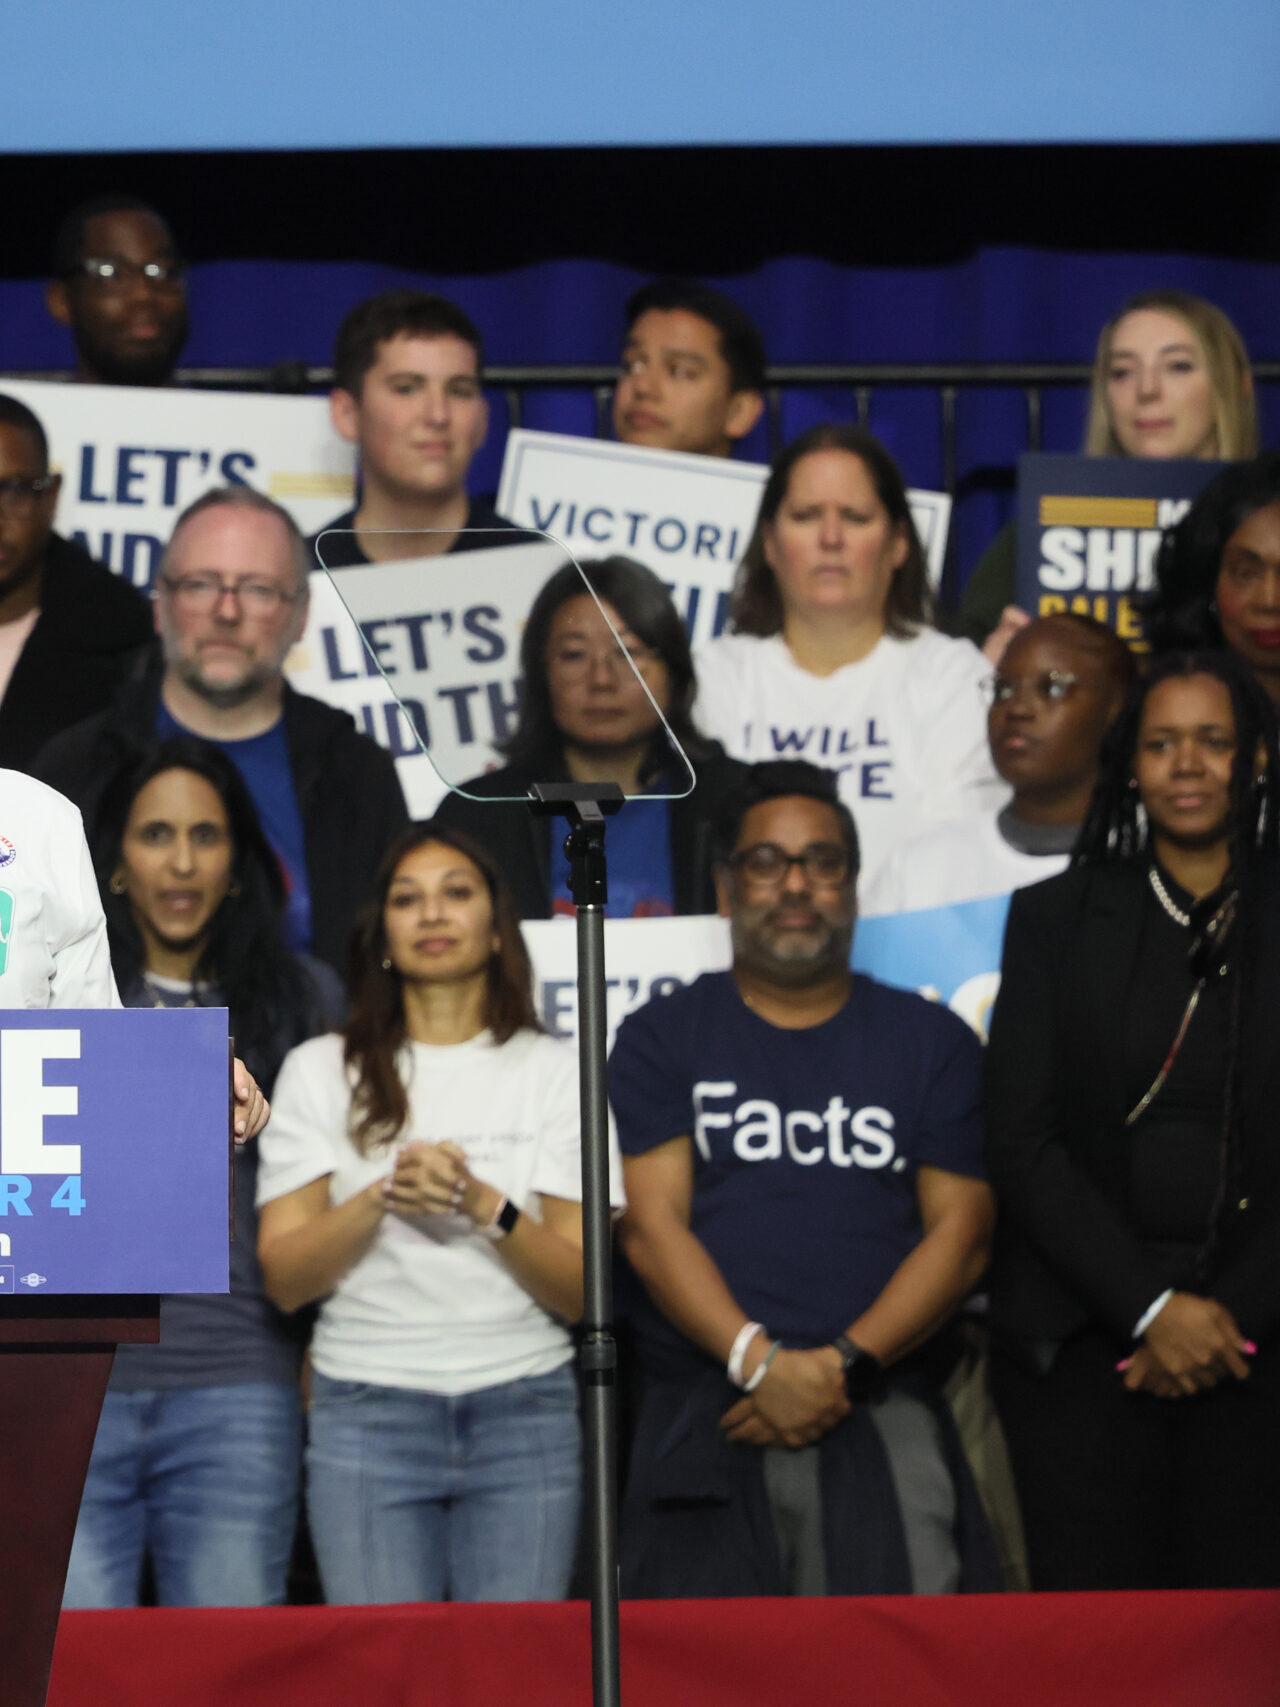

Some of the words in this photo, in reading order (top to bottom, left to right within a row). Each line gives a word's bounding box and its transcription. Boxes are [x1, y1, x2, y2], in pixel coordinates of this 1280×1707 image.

[78, 444, 258, 507] LET'S
[530, 498, 739, 562] VICTORI
[321, 604, 507, 683] LET'S
[770, 718, 889, 755] WILL
[692, 1080, 908, 1173] Facts.
[51, 1175, 86, 1216] 4
